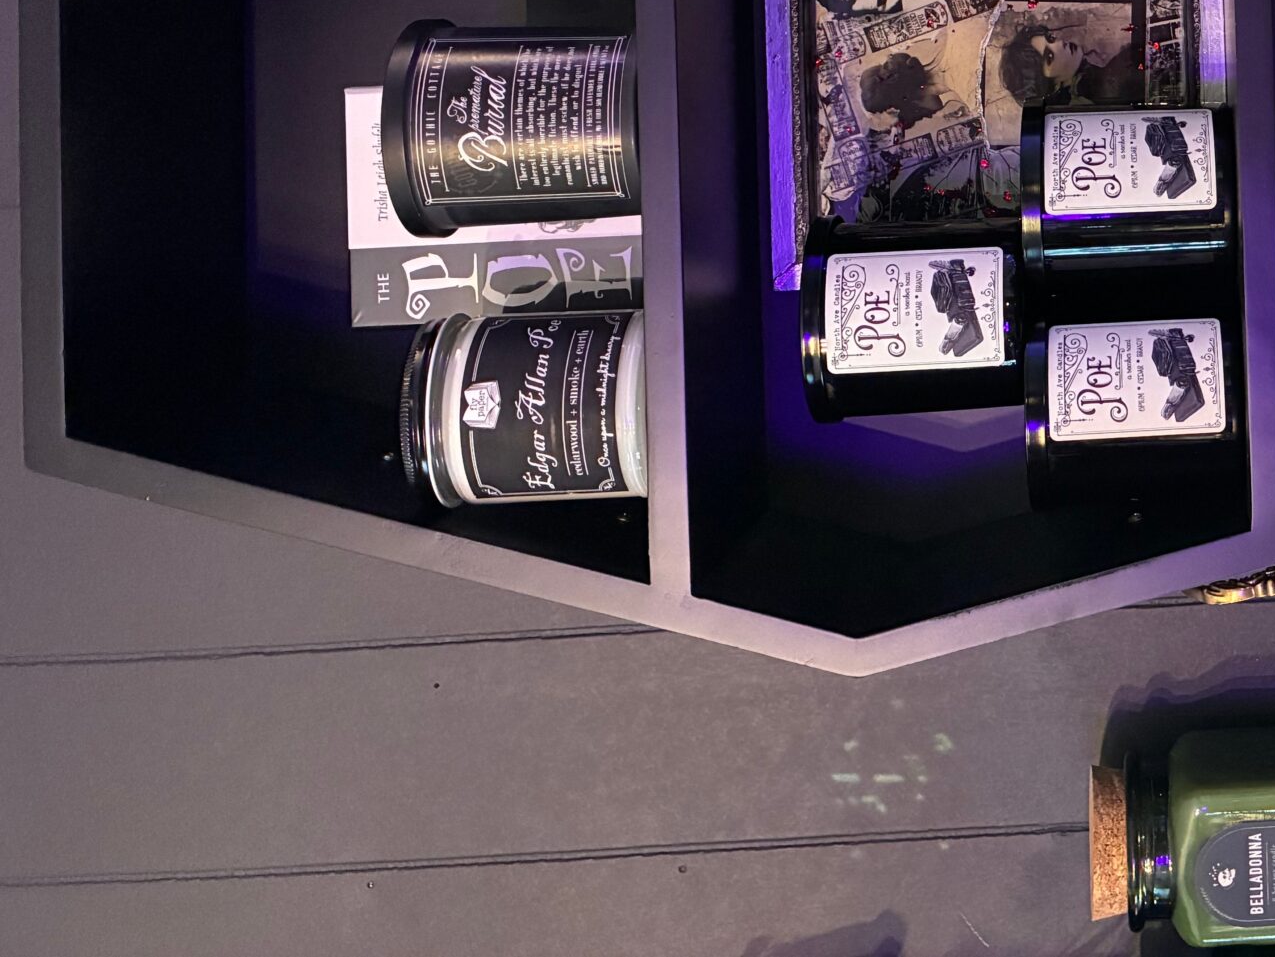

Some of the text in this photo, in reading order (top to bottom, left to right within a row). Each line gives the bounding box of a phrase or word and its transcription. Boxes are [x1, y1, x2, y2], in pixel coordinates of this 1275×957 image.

[467, 74, 487, 135] premature
[514, 88, 524, 115] themes
[537, 84, 547, 96] the
[425, 53, 444, 184] THE GOTHIC COTTAGE
[446, 96, 468, 124] The
[457, 66, 509, 172] Burial
[1051, 168, 1059, 191] North
[1071, 137, 1122, 199] POE
[373, 190, 389, 222] Trisha
[377, 273, 390, 303] THE
[401, 245, 633, 319] POE
[832, 274, 841, 306] Candles
[915, 269, 924, 293] BRANDY
[853, 290, 907, 358] POE
[915, 300, 923, 321] CEDAR
[833, 327, 841, 351] North
[1056, 342, 1064, 371] Candles
[596, 362, 616, 406] midnight
[1076, 355, 1129, 423] POE
[1136, 365, 1145, 385] CEDAR
[469, 397, 480, 411] fly
[477, 390, 488, 418] paper
[514, 319, 563, 490] Edgar Allan Poe
[565, 329, 590, 476] cedarwood smoke earth
[1056, 391, 1064, 416] North
[599, 417, 614, 442] upon
[597, 442, 611, 467] Once
[1248, 832, 1264, 915] BELLADONNA
